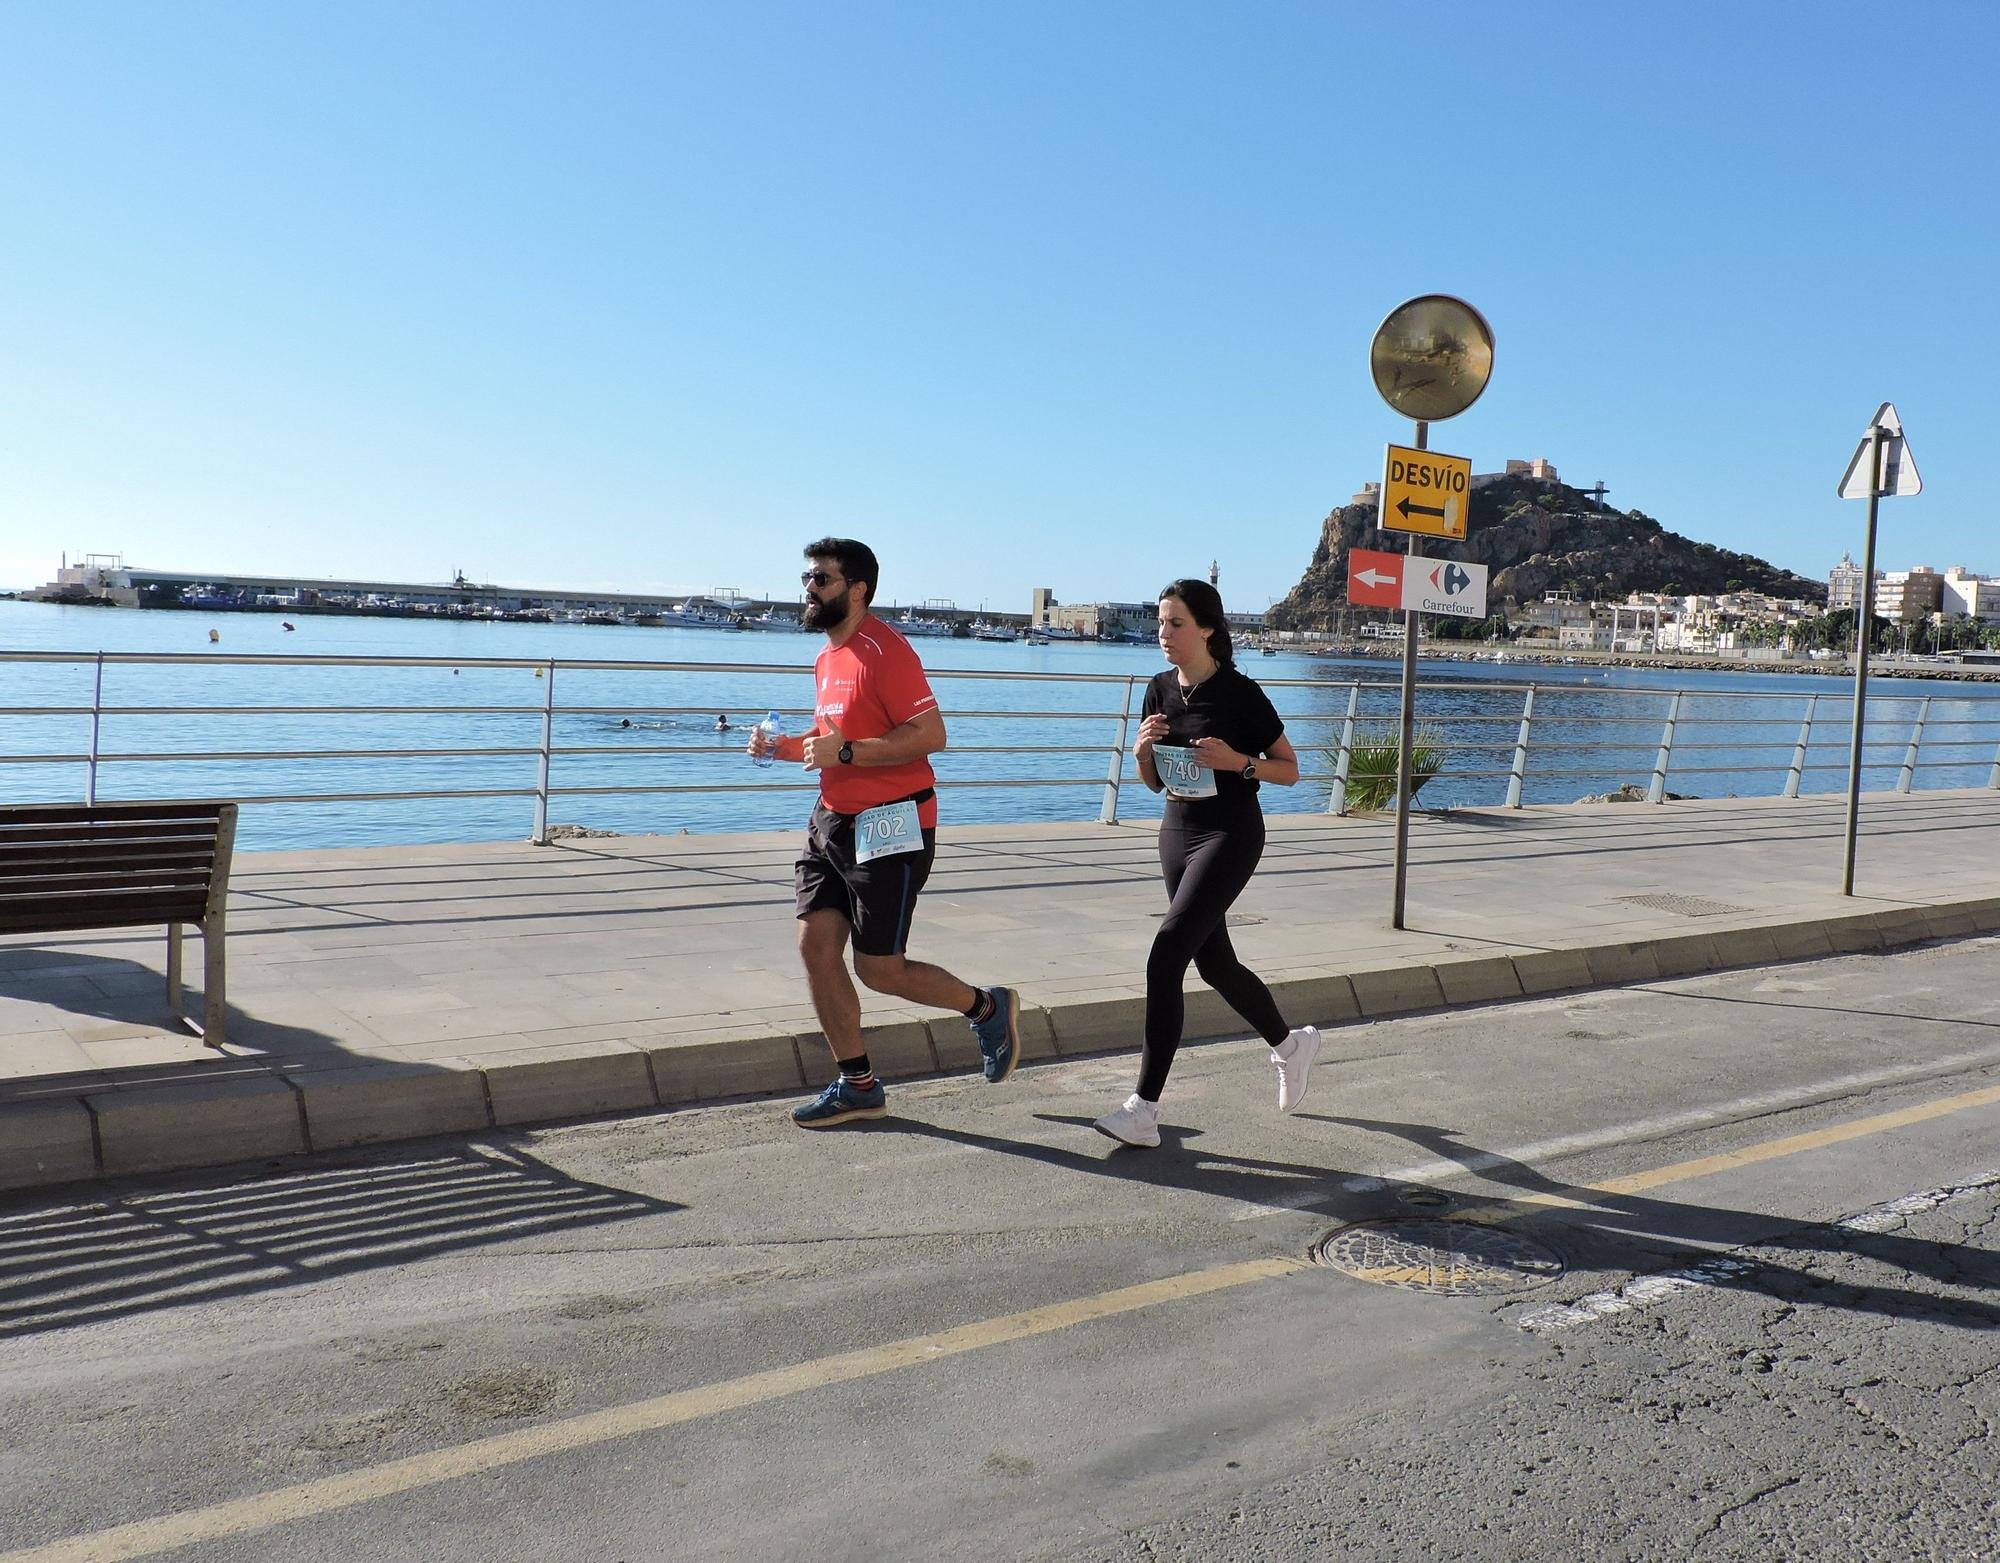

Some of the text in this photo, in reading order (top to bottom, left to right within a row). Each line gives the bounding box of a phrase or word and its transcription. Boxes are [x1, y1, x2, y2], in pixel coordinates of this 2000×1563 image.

[1391, 460, 1466, 493] DESVÍO
[1422, 598, 1475, 615] Carrefour
[1163, 758, 1200, 781] 740
[863, 816, 907, 844] 702
